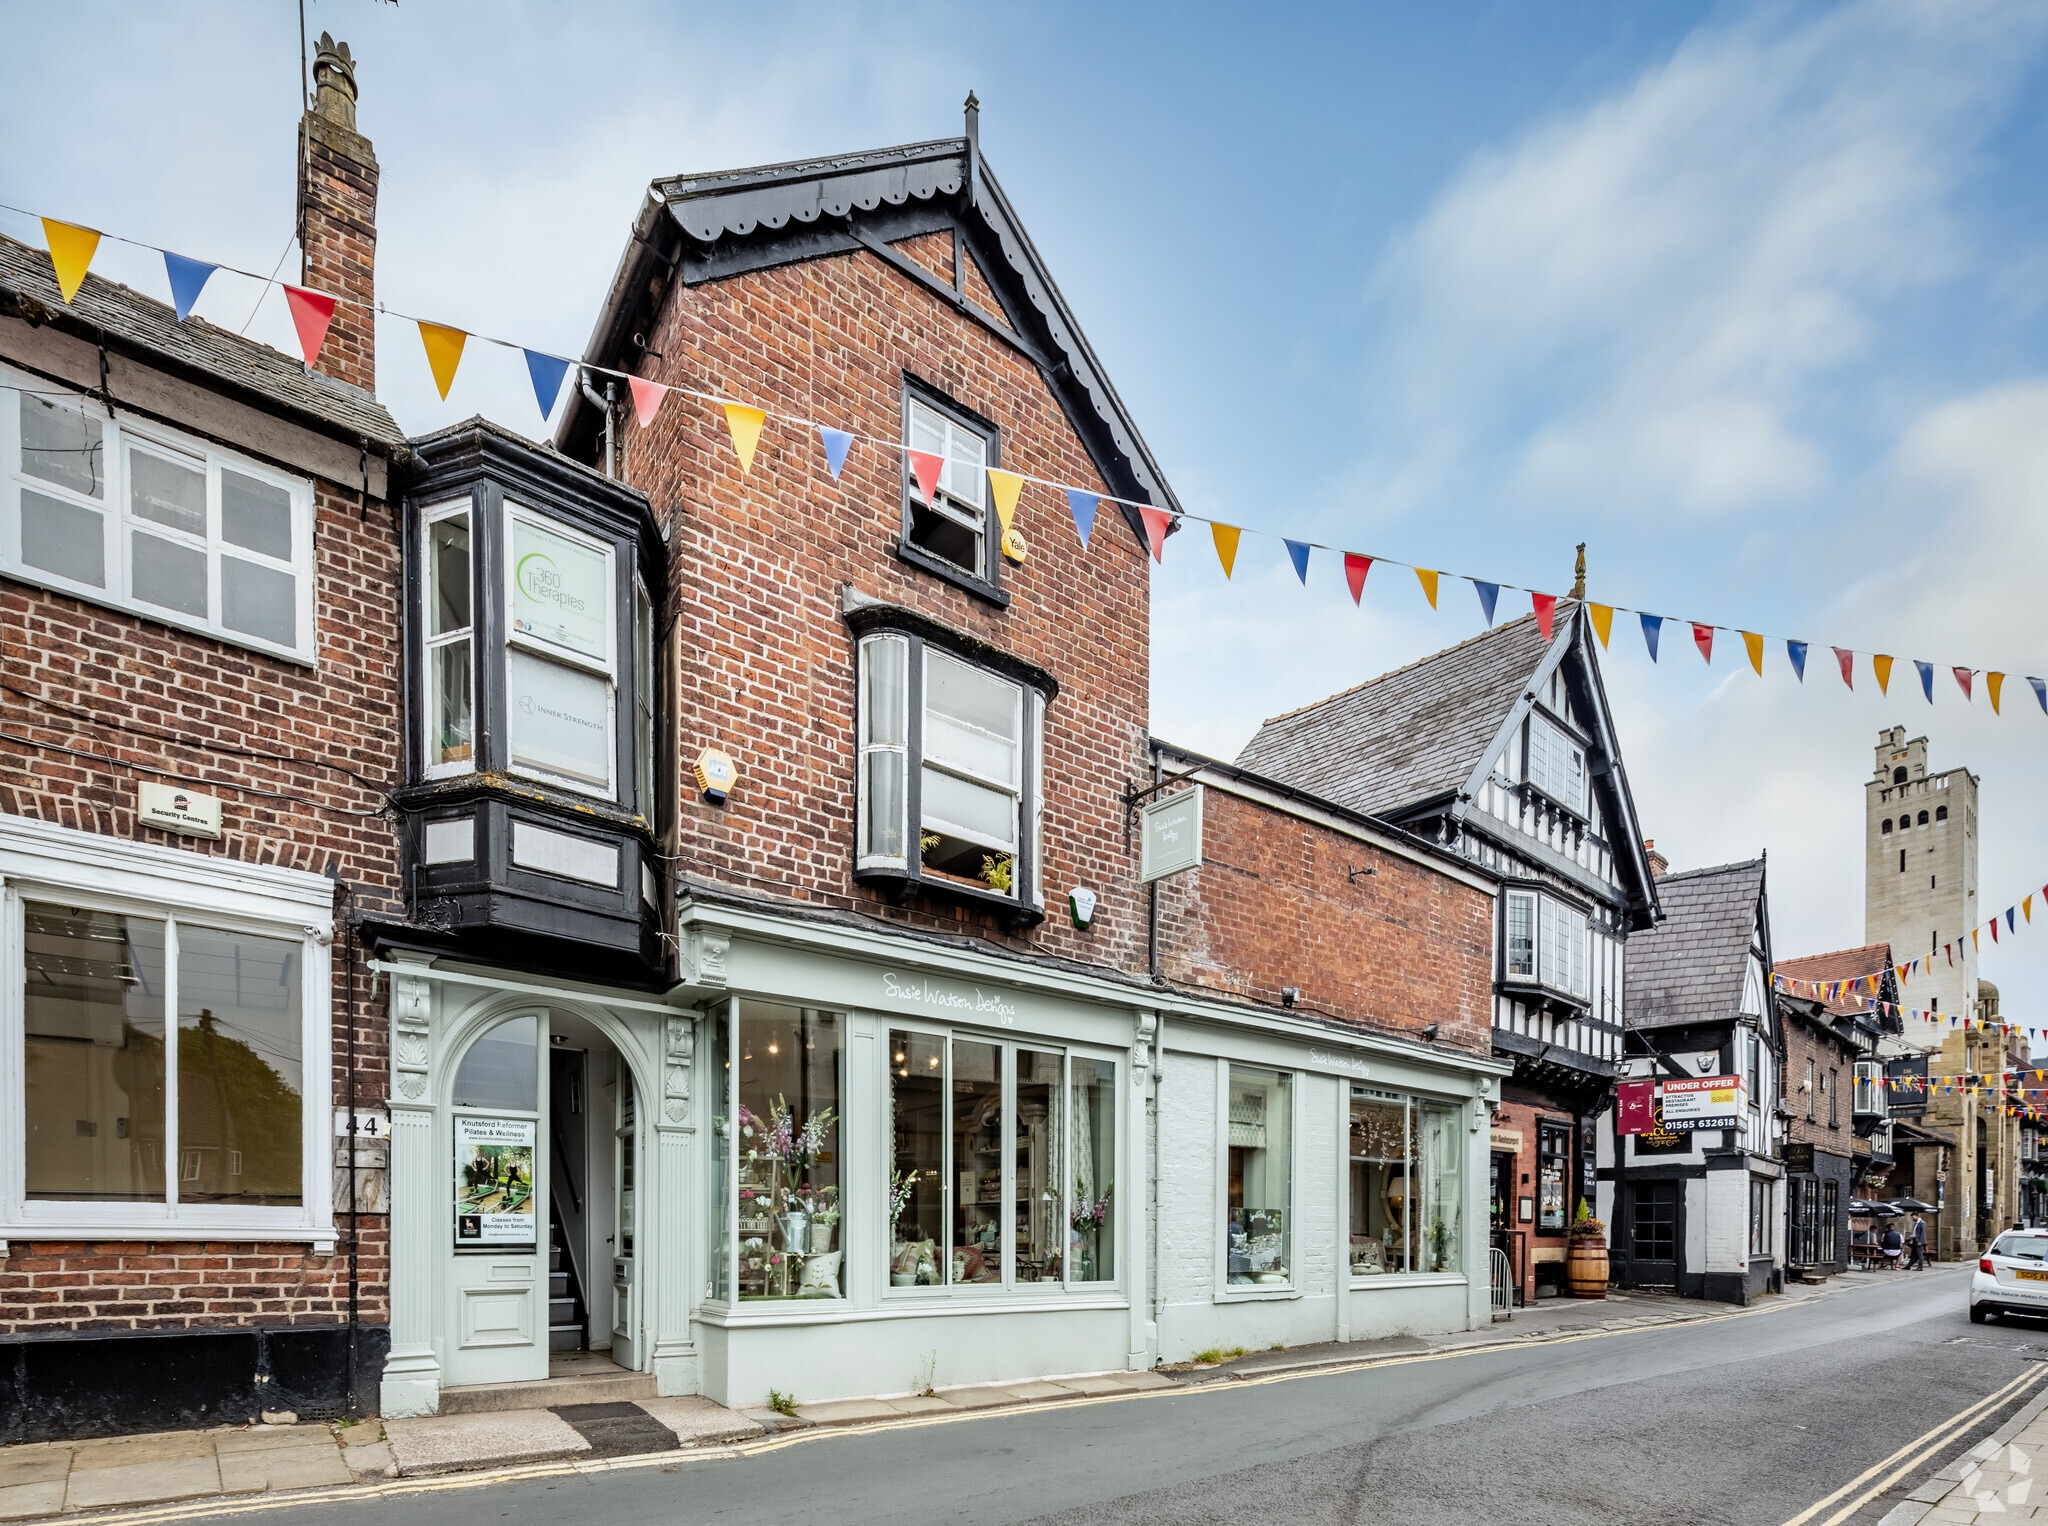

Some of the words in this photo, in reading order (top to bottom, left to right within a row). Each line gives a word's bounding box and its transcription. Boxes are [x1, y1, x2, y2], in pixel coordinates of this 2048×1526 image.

[1009, 537, 1025, 552] Yale
[525, 571, 585, 611] Therapies
[537, 705, 562, 720] INNER
[563, 713, 603, 731] STRENGTH
[709, 763, 728, 778] ADT
[151, 808, 180, 820] Security
[182, 814, 208, 825] Centres
[883, 972, 922, 1000] Susie
[923, 979, 974, 1011] Watson
[975, 987, 1016, 1025] Designs
[1667, 1081, 1700, 1091] UNDER
[1701, 1079, 1734, 1089] OFFER
[1711, 1094, 1734, 1103] savills
[461, 1119, 496, 1128] Knutsford
[497, 1121, 528, 1129] Reformer
[1665, 1120, 1695, 1130] 01565
[1698, 1118, 1735, 1128] 632618
[464, 1128, 487, 1136] Pilates
[496, 1129, 525, 1137] Wellness
[2020, 1271, 2038, 1279] SG15
